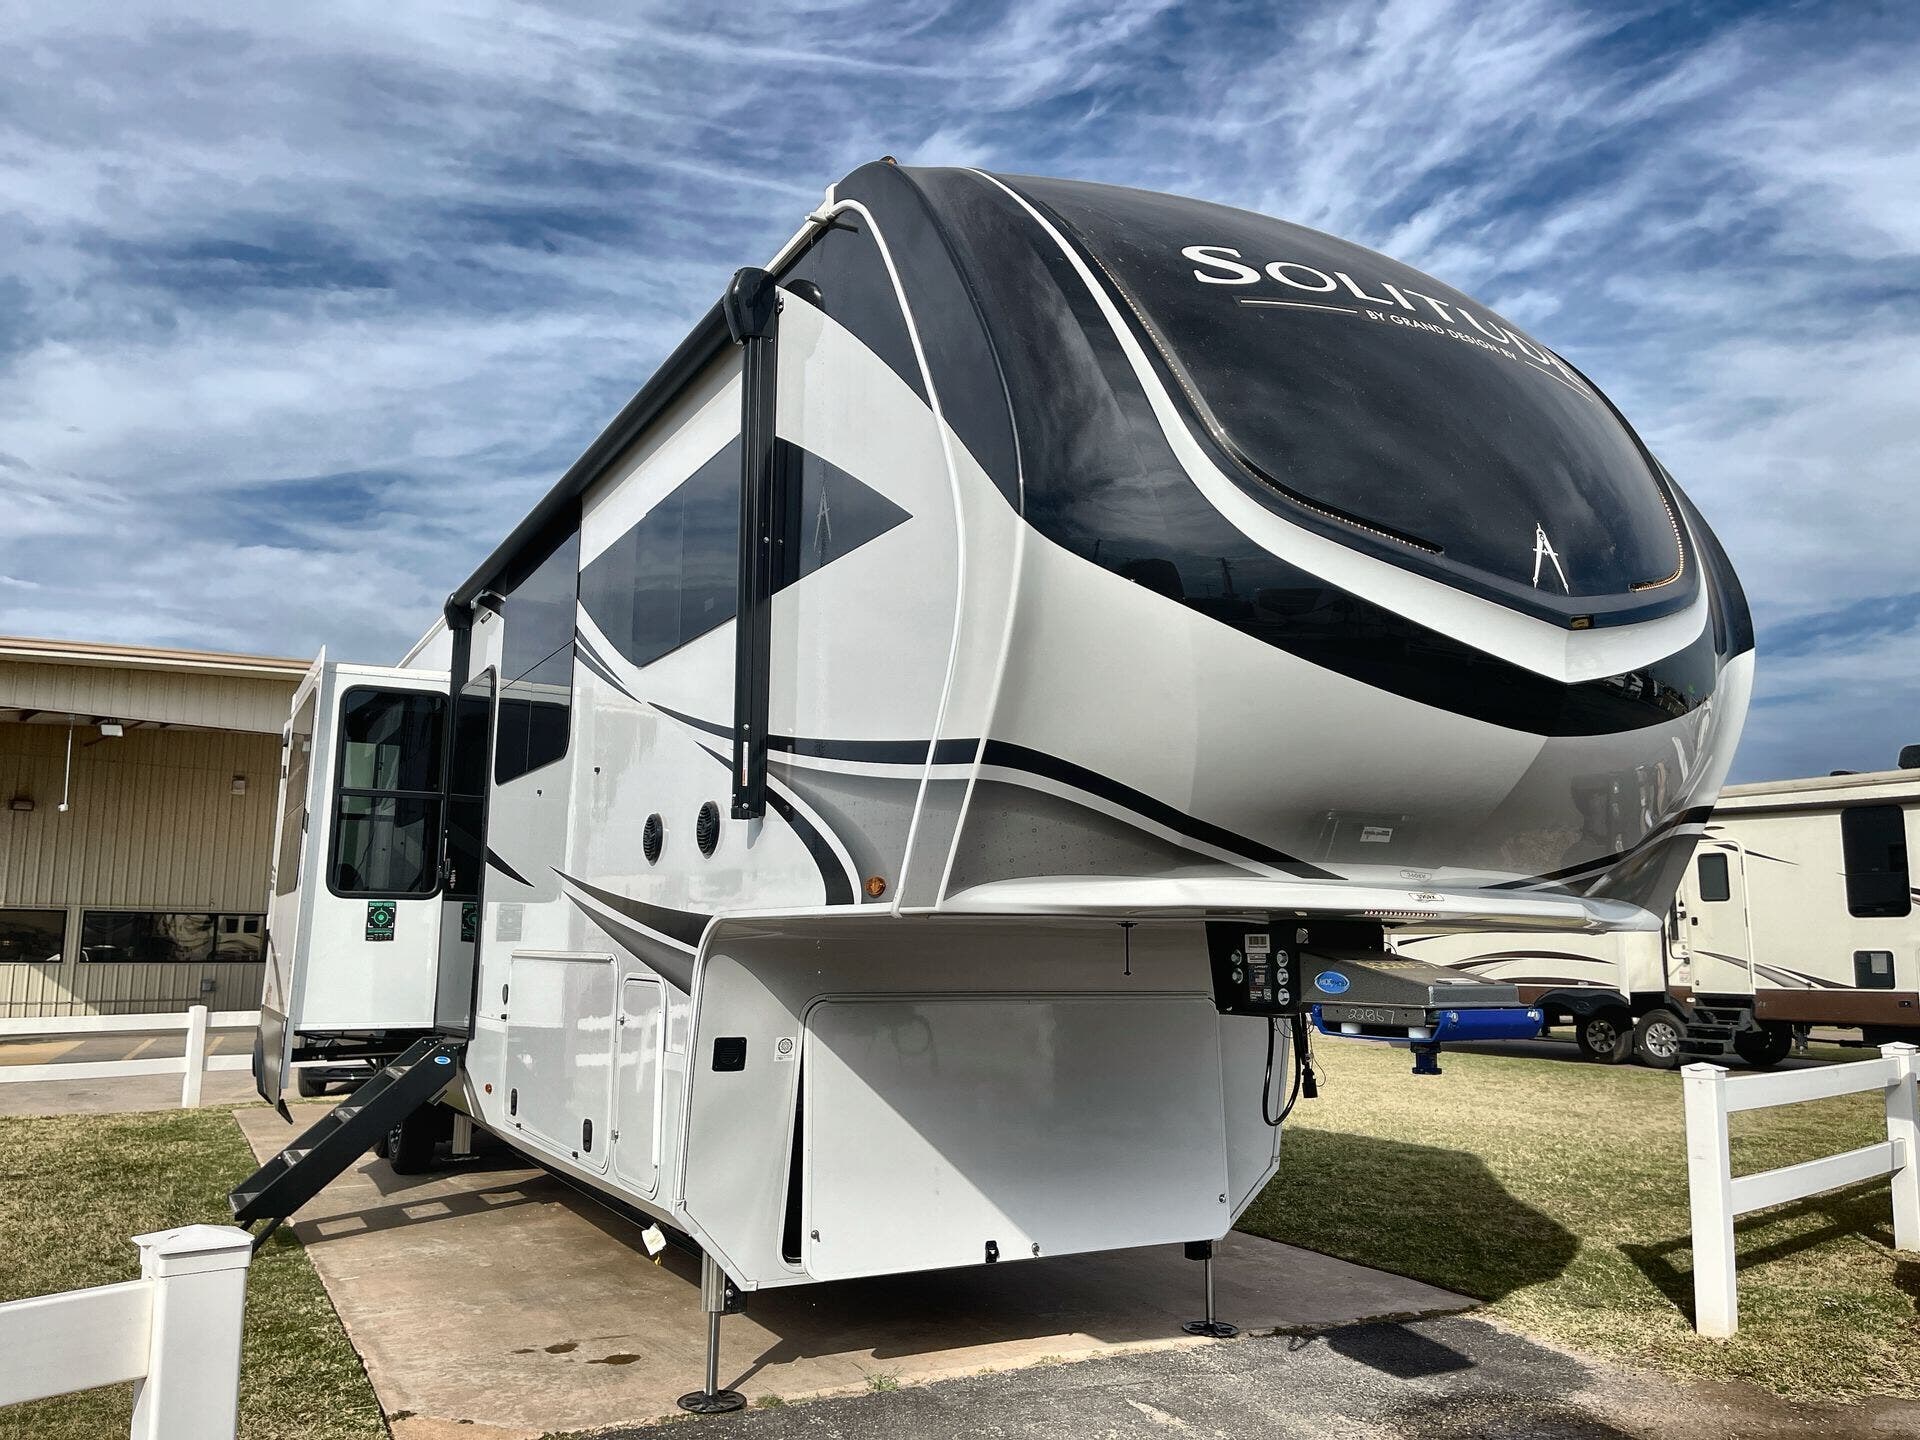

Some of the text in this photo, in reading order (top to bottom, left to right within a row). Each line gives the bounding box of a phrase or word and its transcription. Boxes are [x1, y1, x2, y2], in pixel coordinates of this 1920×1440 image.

[1181, 245, 1590, 394] SOLITUDE
[1366, 309, 1518, 361] BY GRAND DESIGN RV
